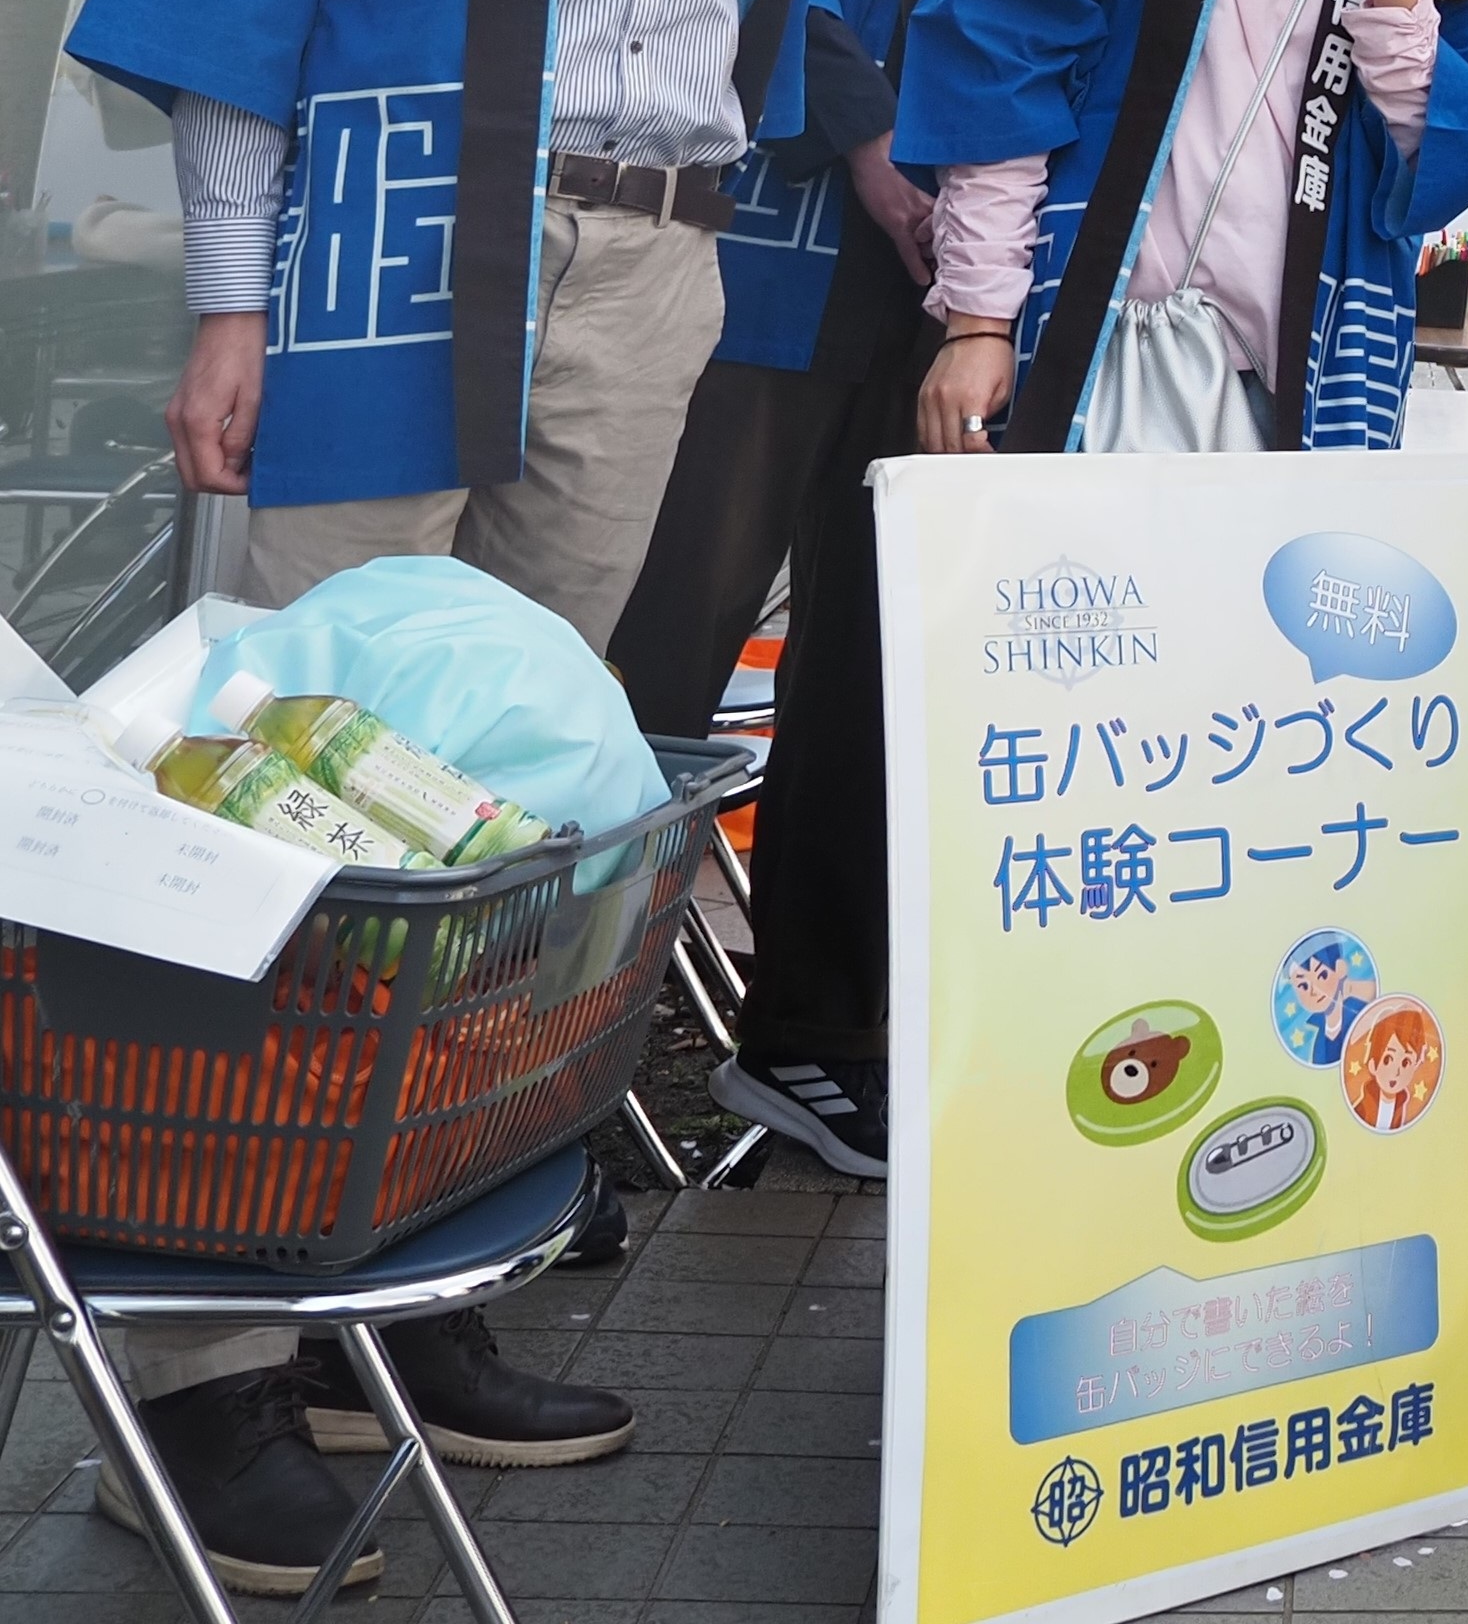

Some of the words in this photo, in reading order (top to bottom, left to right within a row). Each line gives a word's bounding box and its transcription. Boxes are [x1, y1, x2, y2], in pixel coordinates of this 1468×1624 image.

[994, 573, 1146, 612] SHOWA
[1073, 610, 1110, 630] 1932
[1304, 569, 1411, 654] 無料
[983, 631, 1159, 675] SHINKIN
[977, 693, 1461, 806] 缶バッジづくり
[277, 789, 375, 862] 緑茶
[992, 800, 1461, 934] 体験コーナー
[1106, 1271, 1354, 1358] 自分で書いた絵を
[1119, 1381, 1436, 1519] 昭和信用金庫
